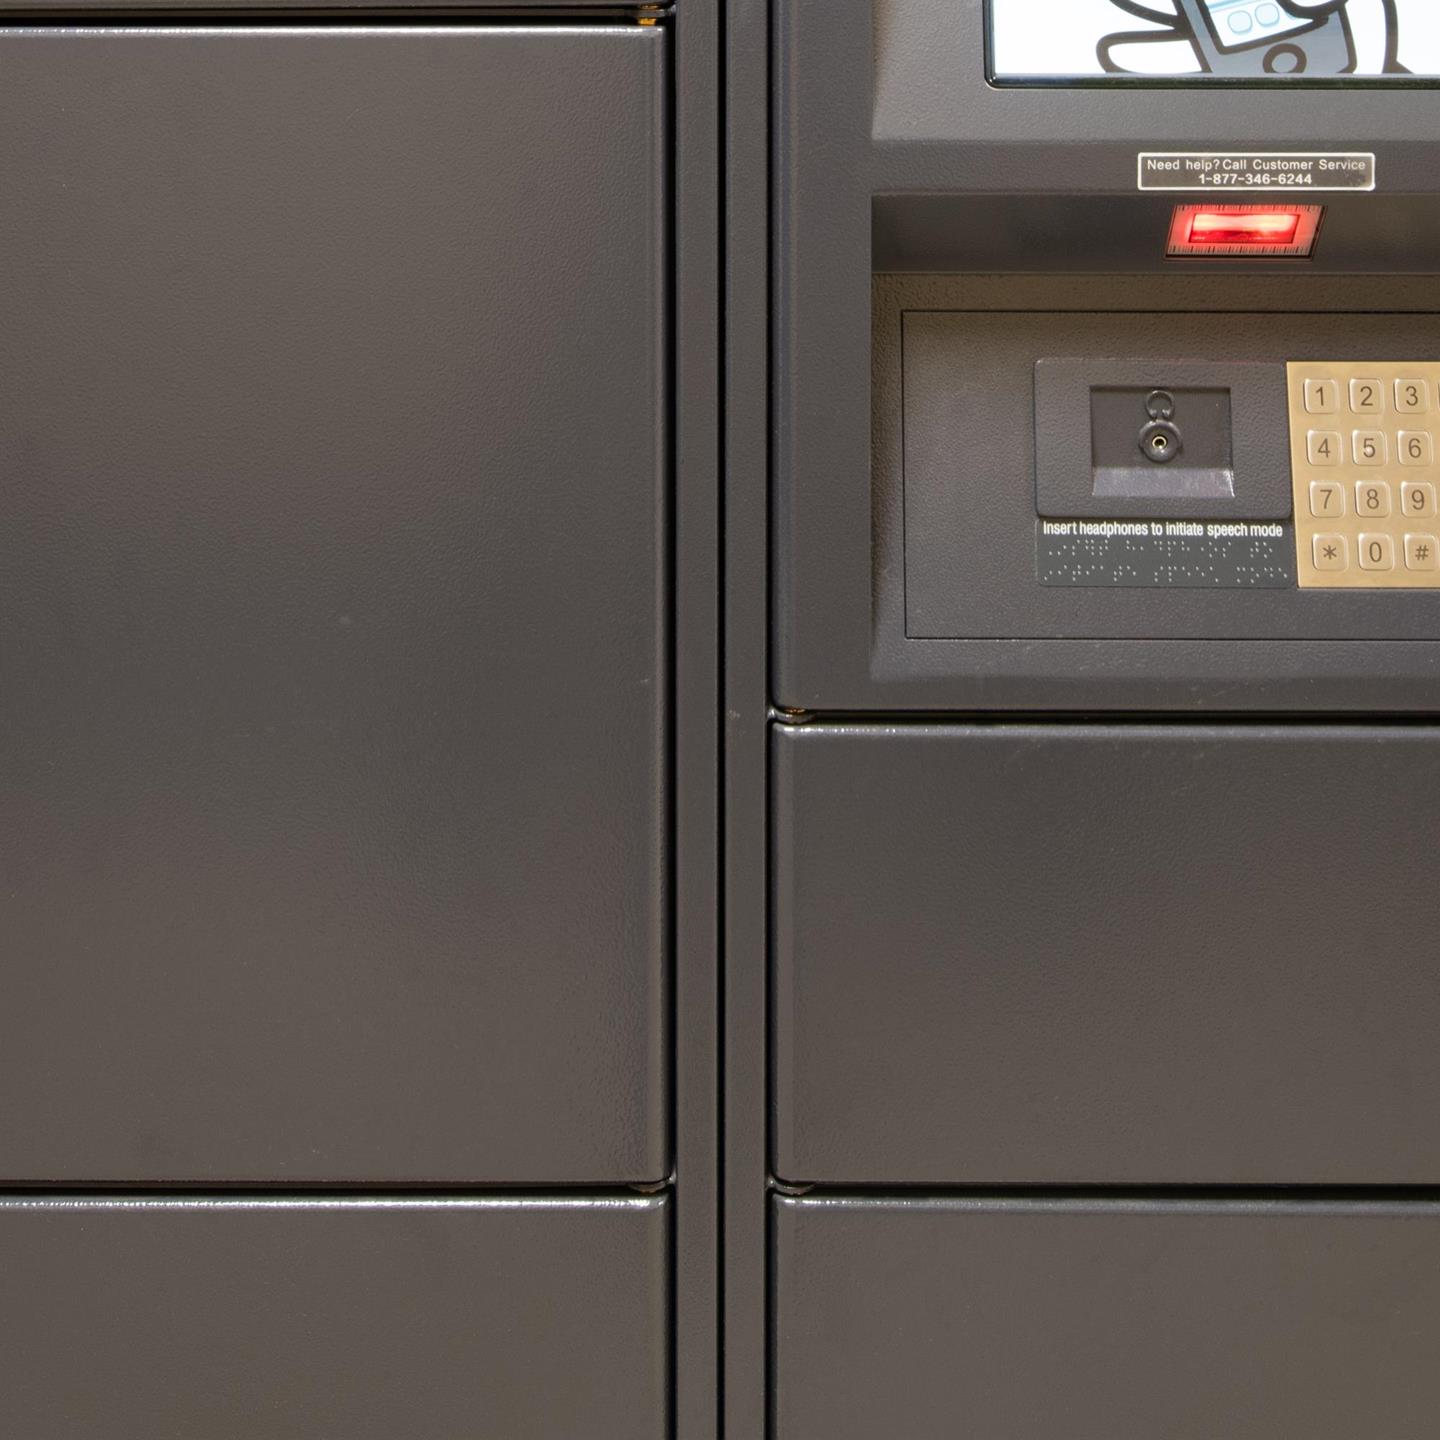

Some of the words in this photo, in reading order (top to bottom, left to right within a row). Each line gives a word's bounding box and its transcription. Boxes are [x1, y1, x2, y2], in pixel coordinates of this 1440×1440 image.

[1147, 160, 1180, 170] Need
[1186, 160, 1219, 172] help?
[1222, 160, 1247, 170] Call
[1252, 160, 1313, 170] Customer
[1318, 160, 1365, 170] Service
[1198, 174, 1312, 184] 1-877-346-6244
[1315, 387, 1324, 406] 1
[1360, 386, 1373, 406] 2
[1406, 386, 1418, 406] 3
[1318, 438, 1330, 458] 4
[1363, 438, 1375, 458] 5
[1409, 439, 1421, 458] 6
[1320, 490, 1332, 509] 7
[1367, 489, 1379, 509] 8
[1412, 490, 1424, 509] 9
[1043, 521, 1077, 535] Insert
[1079, 521, 1148, 538] headphones
[1151, 522, 1162, 535] to
[1166, 522, 1203, 536] initiate
[1207, 523, 1248, 538] speech
[1250, 523, 1282, 537] mode
[1369, 542, 1382, 562] 0
